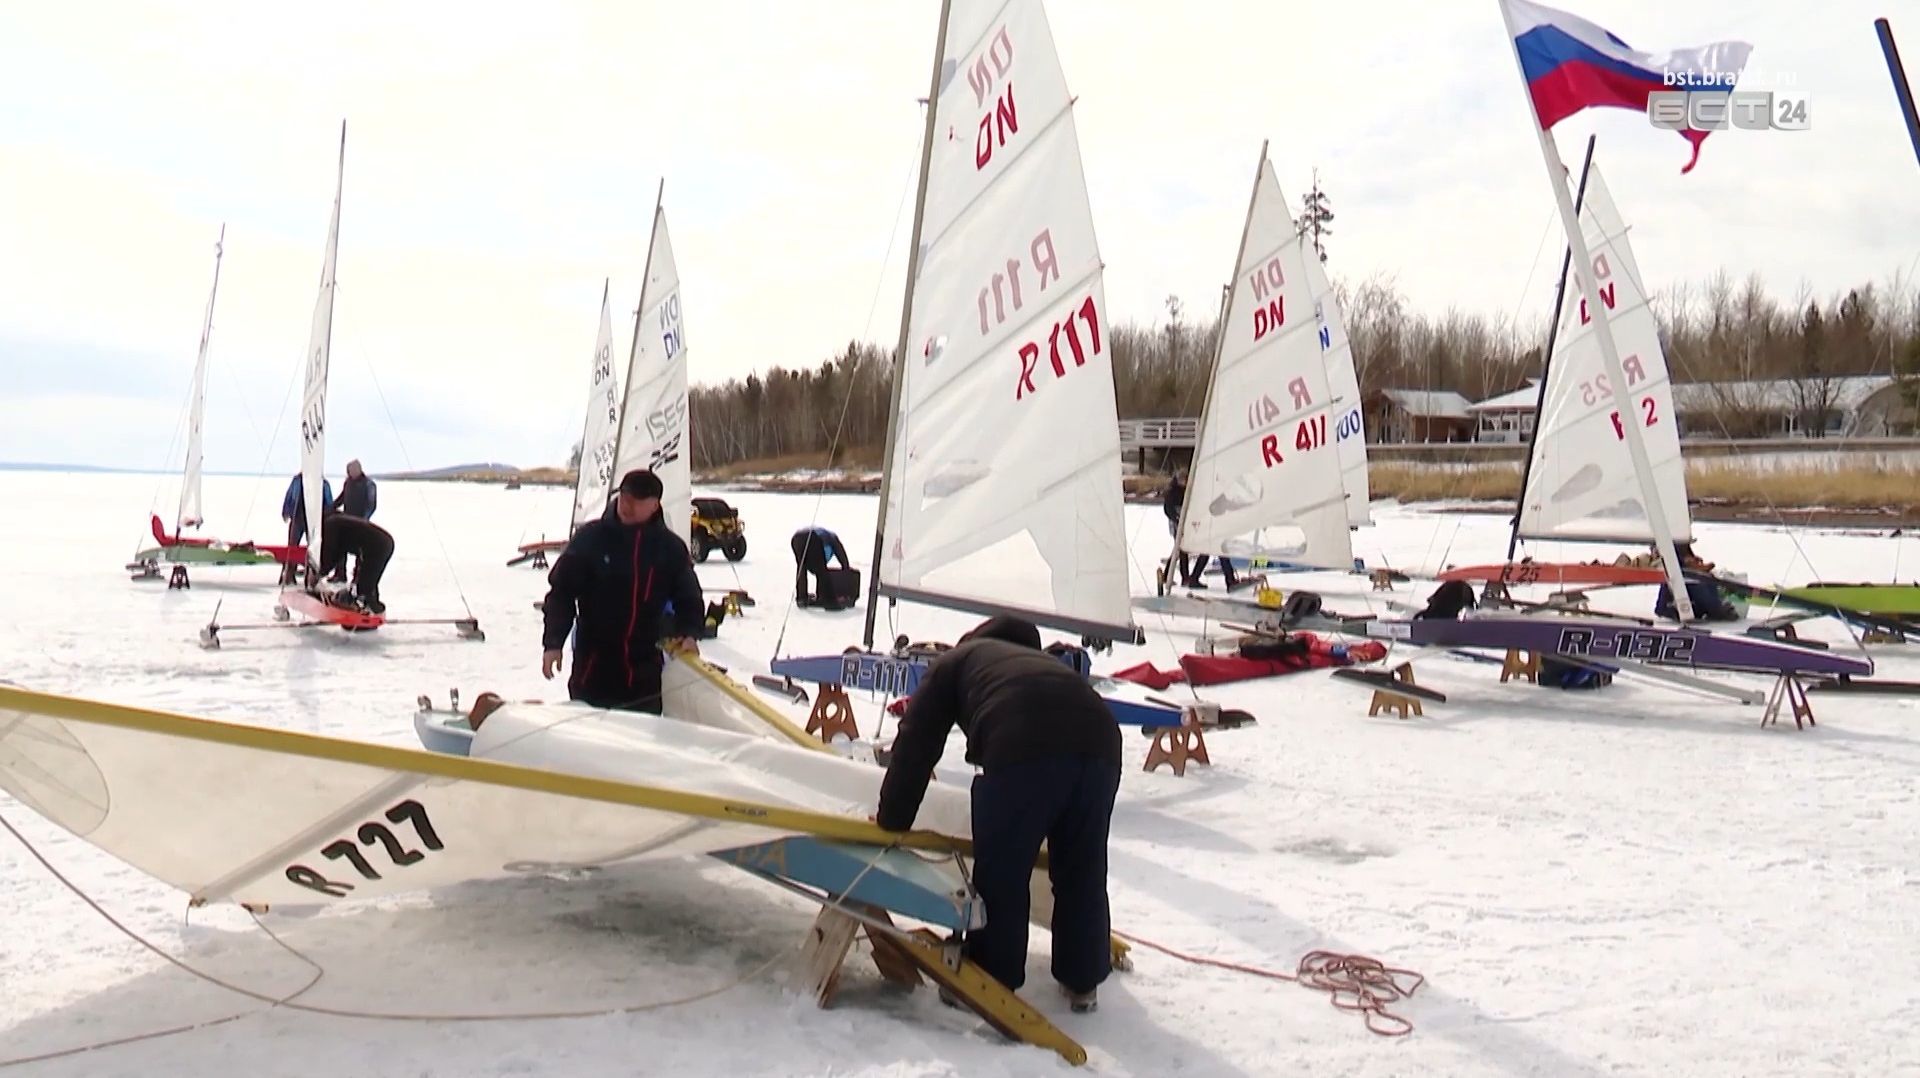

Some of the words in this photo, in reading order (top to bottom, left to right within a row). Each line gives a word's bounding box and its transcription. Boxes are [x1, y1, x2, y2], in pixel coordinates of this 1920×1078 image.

[976, 80, 1018, 171] DN
[664, 324, 680, 360] DN
[1254, 294, 1285, 342] DN
[1016, 341, 1039, 401] R
[1048, 295, 1100, 378] 111
[1262, 433, 1284, 469] R
[1295, 413, 1326, 452] 411
[1557, 627, 1697, 663] R-132
[841, 655, 909, 697] R-111
[285, 864, 355, 898] R
[320, 798, 445, 880] 727
